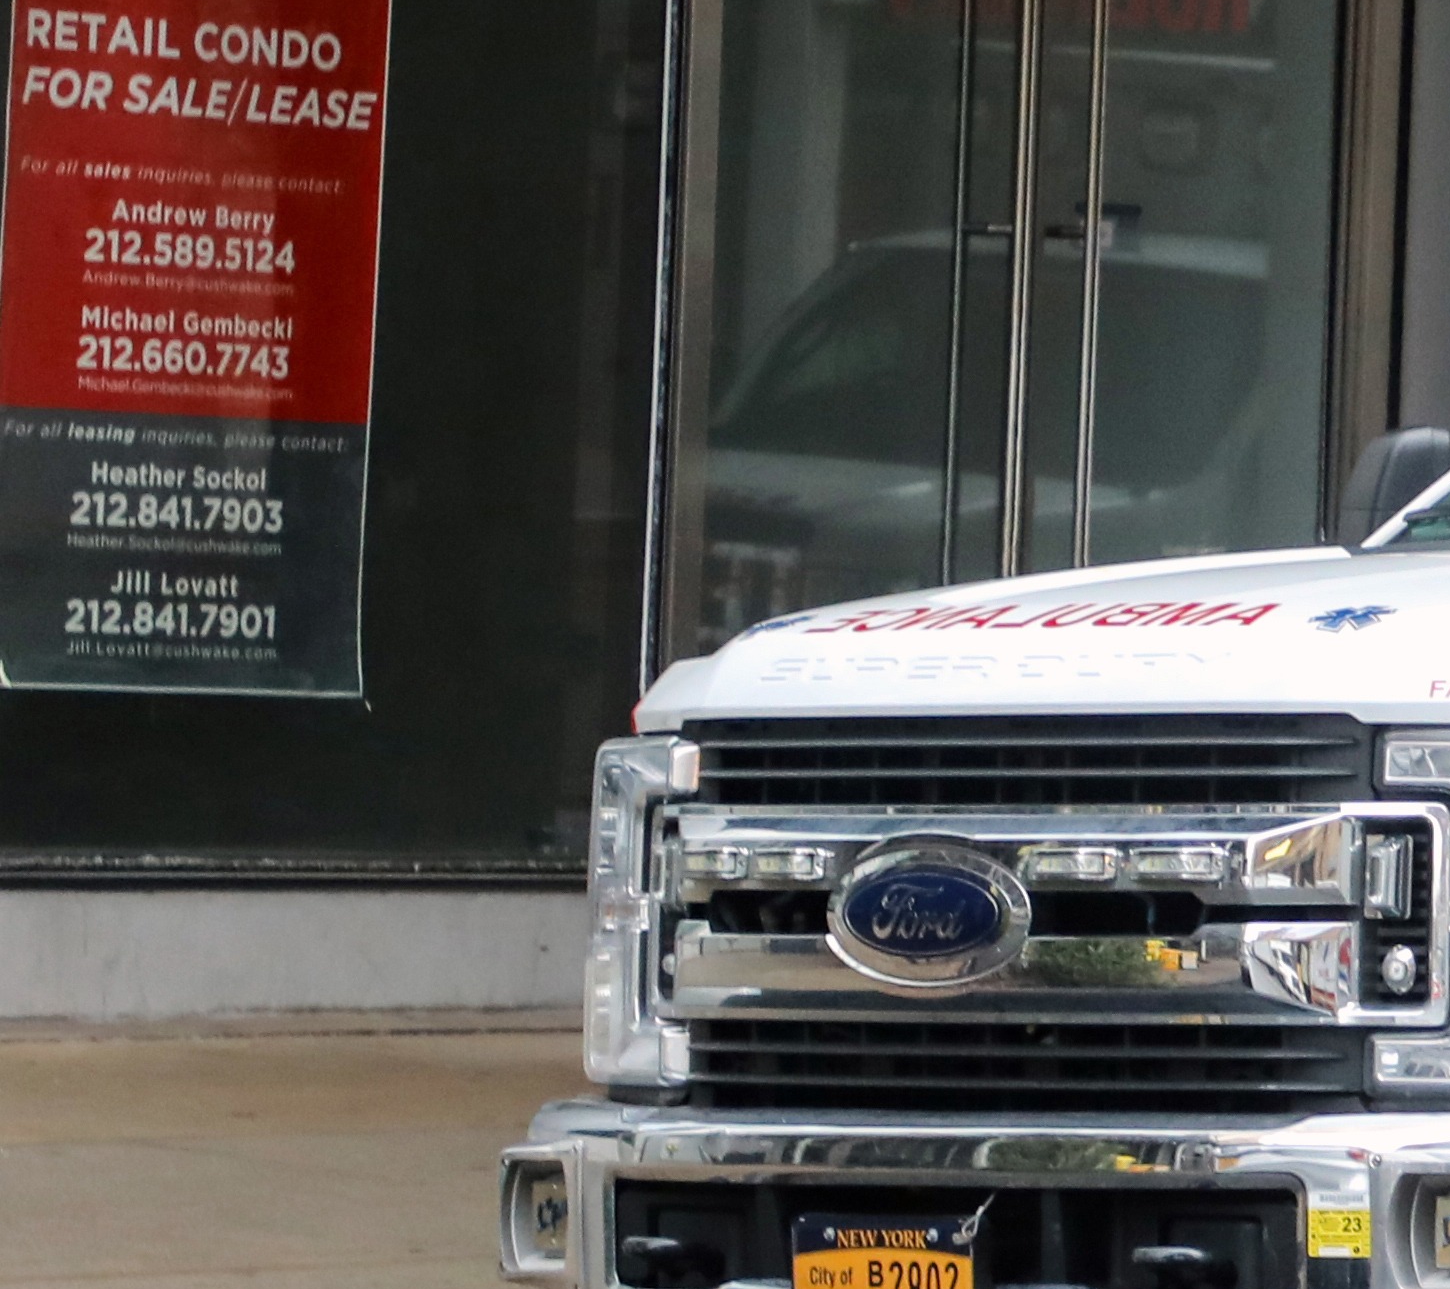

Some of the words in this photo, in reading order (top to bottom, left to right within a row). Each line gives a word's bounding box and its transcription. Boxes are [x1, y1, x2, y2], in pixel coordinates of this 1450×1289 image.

[26, 8, 181, 60] RETAIL
[194, 22, 342, 72] CONDO
[22, 65, 114, 112] FOR
[123, 72, 378, 132] SALE/LEASE
[20, 155, 49, 176] For
[55, 160, 79, 176] all
[84, 162, 131, 181] sales
[112, 198, 207, 228] Andrew
[215, 205, 275, 236] Berry
[84, 228, 296, 275] 212.589.5124
[81, 305, 176, 334] Michael
[77, 334, 291, 382] 212.660.7743
[3, 419, 34, 437] For
[40, 420, 62, 438] all
[68, 422, 136, 444] leasing
[90, 460, 187, 489] Heather
[192, 466, 267, 492] Sockol
[69, 491, 284, 535] 212.841.7903
[110, 570, 150, 595] Jill
[160, 572, 240, 599] Lovatt
[64, 598, 277, 641] 212.841.7901
[871, 882, 967, 941] Ford
[836, 1228, 878, 1249] NEW
[881, 1228, 928, 1250] YORK
[1342, 1216, 1362, 1233] 23
[809, 1265, 837, 1289] City
[839, 1266, 853, 1286] of
